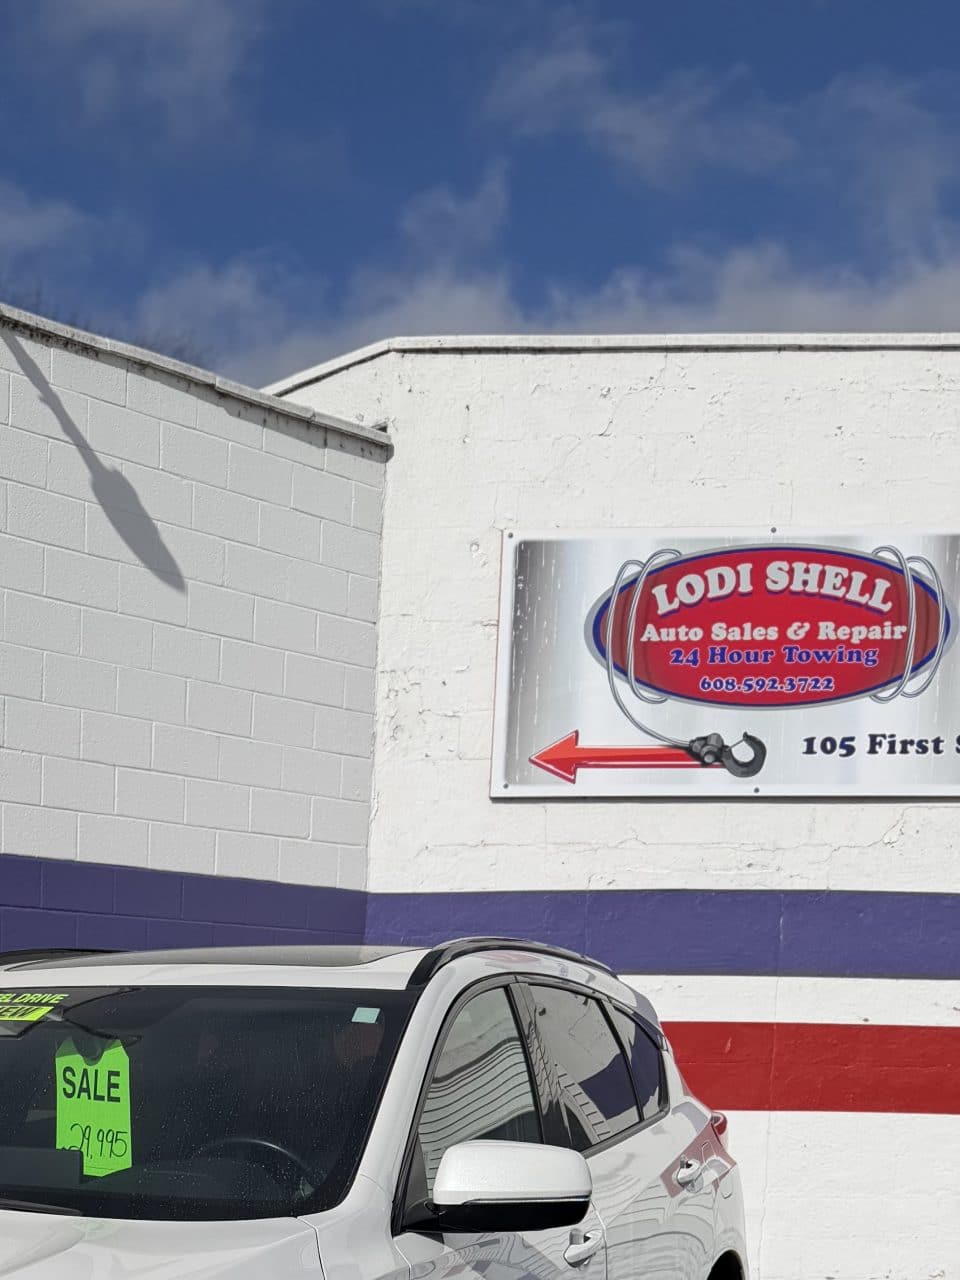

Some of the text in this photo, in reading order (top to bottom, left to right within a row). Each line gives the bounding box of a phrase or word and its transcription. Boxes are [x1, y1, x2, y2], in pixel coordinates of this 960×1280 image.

[651, 561, 893, 617] LODI SHELL
[640, 621, 908, 644] Auto Sales & Repair
[670, 646, 880, 666] 24 Hour Towing
[699, 676, 835, 693] 608.592.3722
[802, 736, 856, 757] 105
[867, 734, 945, 755] First
[12, 993, 69, 1003] DRIVE
[62, 1066, 121, 1103] SALE
